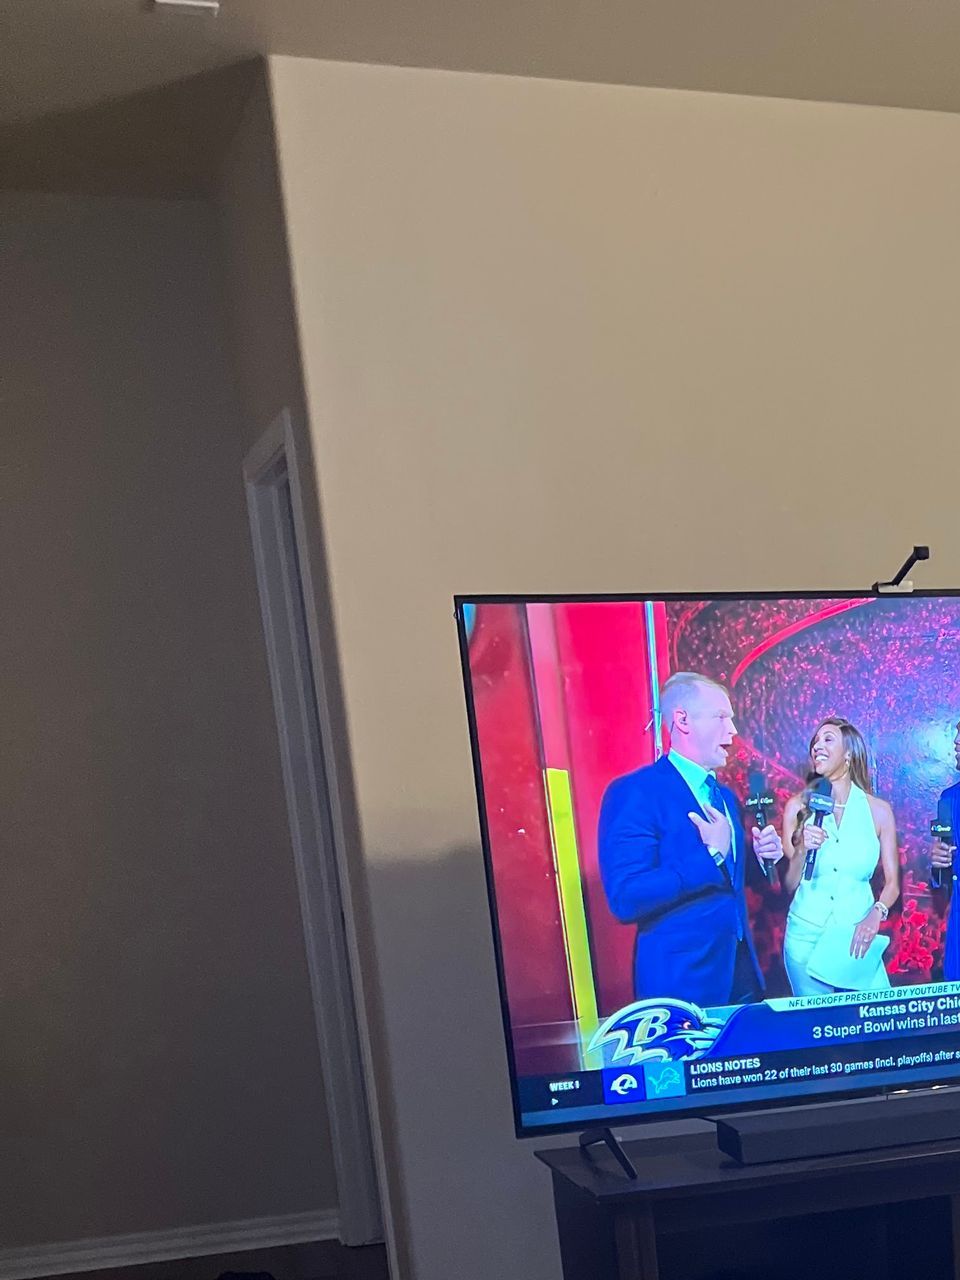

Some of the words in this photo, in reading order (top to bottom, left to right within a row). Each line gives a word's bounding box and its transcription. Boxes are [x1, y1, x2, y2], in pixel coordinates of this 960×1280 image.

[788, 1000, 805, 1008] NFL
[807, 995, 845, 1006] KICKOFF
[846, 990, 895, 1003] PRESENTED
[897, 989, 908, 998] BY
[910, 985, 948, 996] YOUTUBE
[859, 1000, 907, 1018] Kansas
[908, 998, 935, 1014] City
[812, 1026, 822, 1039] 3
[824, 1023, 862, 1040] Super
[864, 1018, 895, 1034] Bowl
[897, 1015, 925, 1030] wins
[927, 1014, 938, 1027] in
[690, 1062, 723, 1075] LIONS
[725, 1058, 761, 1071] NOTES
[691, 1077, 717, 1089] Lions
[719, 1074, 742, 1086] have
[743, 1073, 763, 1083] won
[764, 1069, 778, 1081] 22
[779, 1068, 789, 1078] of
[790, 1066, 812, 1078] their
[812, 1064, 829, 1075] last
[830, 1062, 843, 1073] 30
[845, 1060, 874, 1073] games
[875, 1056, 896, 1069] (incl.
[897, 1052, 934, 1067] playoffs)
[935, 1050, 955, 1061] after
[549, 1080, 574, 1092] WEEK
[575, 1080, 581, 1090] 1
